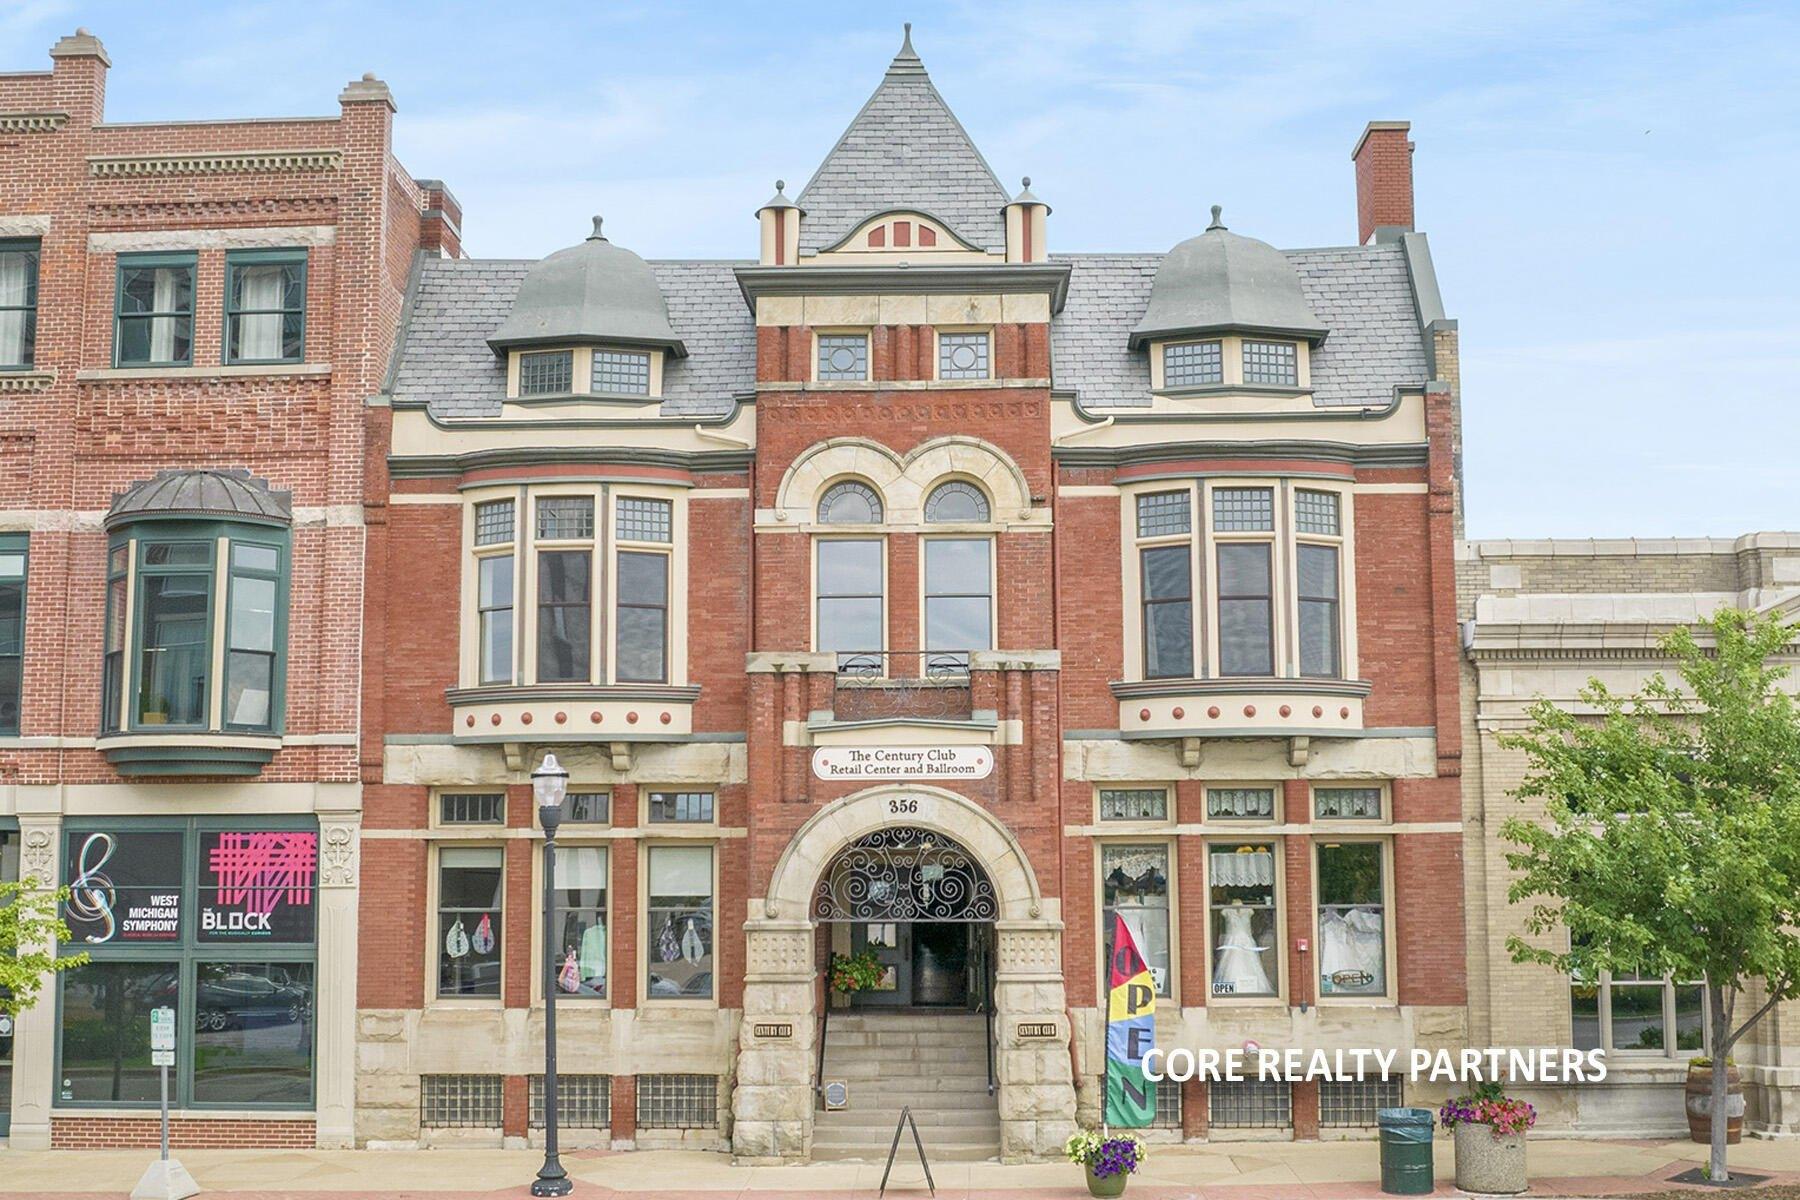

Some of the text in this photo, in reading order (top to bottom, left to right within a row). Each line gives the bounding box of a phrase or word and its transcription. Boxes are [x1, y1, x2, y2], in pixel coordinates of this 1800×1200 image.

[848, 749, 956, 764] The Century Club
[830, 763, 975, 775] Retail Center and Ballroom
[888, 799, 918, 814] 356
[150, 895, 179, 906] WEST
[129, 907, 178, 919] MICHIGAN
[122, 919, 178, 932] SYMPHONY
[202, 911, 272, 930] BLOCK
[1333, 971, 1372, 985] OPEN
[1214, 983, 1234, 993] OPEN
[1116, 946, 1153, 1111] OPEN
